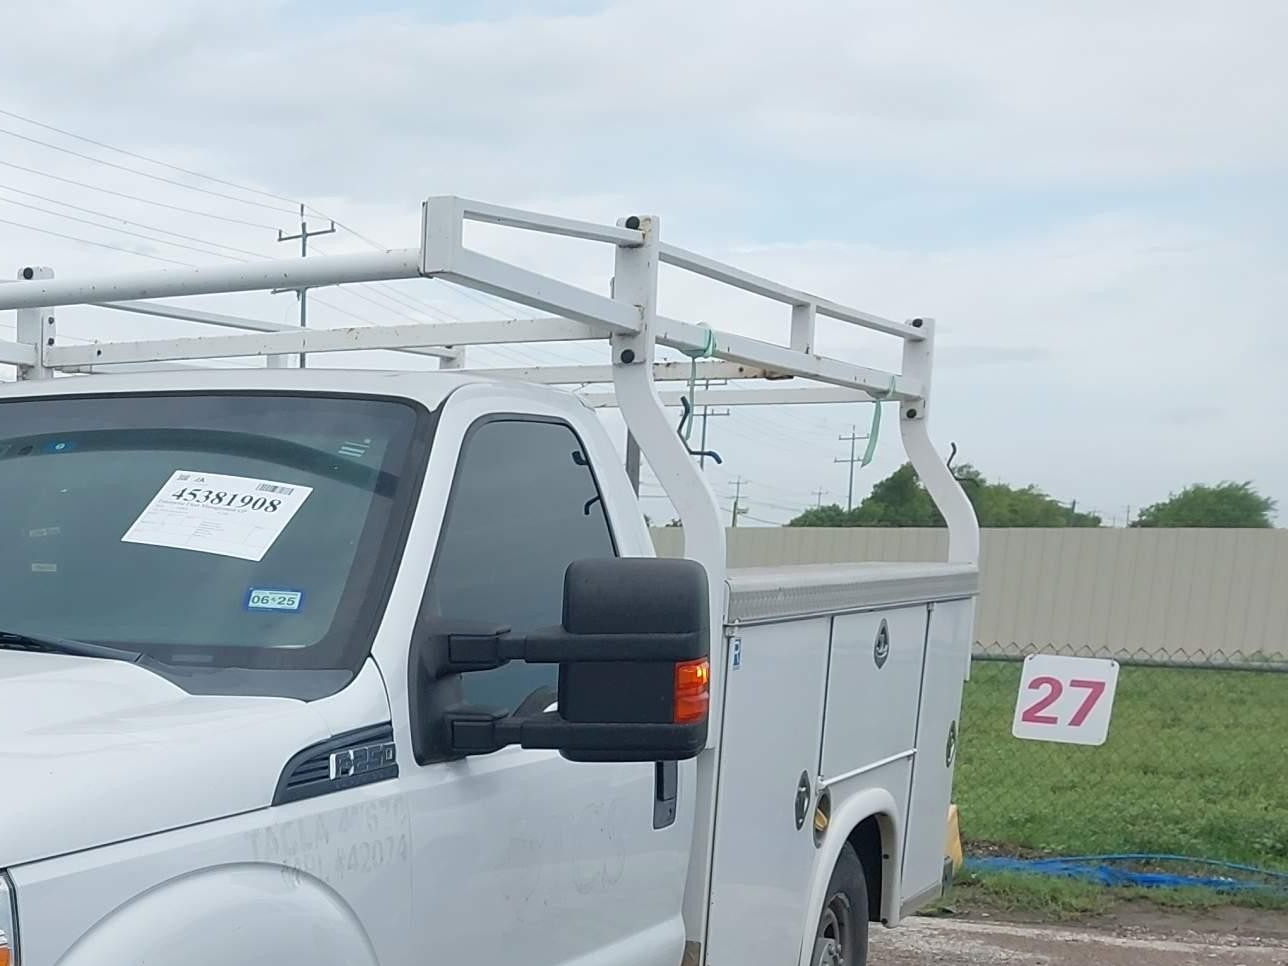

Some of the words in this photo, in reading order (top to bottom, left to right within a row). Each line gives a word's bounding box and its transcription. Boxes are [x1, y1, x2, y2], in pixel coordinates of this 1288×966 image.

[172, 487, 282, 513] 45381908
[251, 595, 270, 604] 06
[277, 596, 296, 606] 25
[1020, 675, 1107, 728] 27
